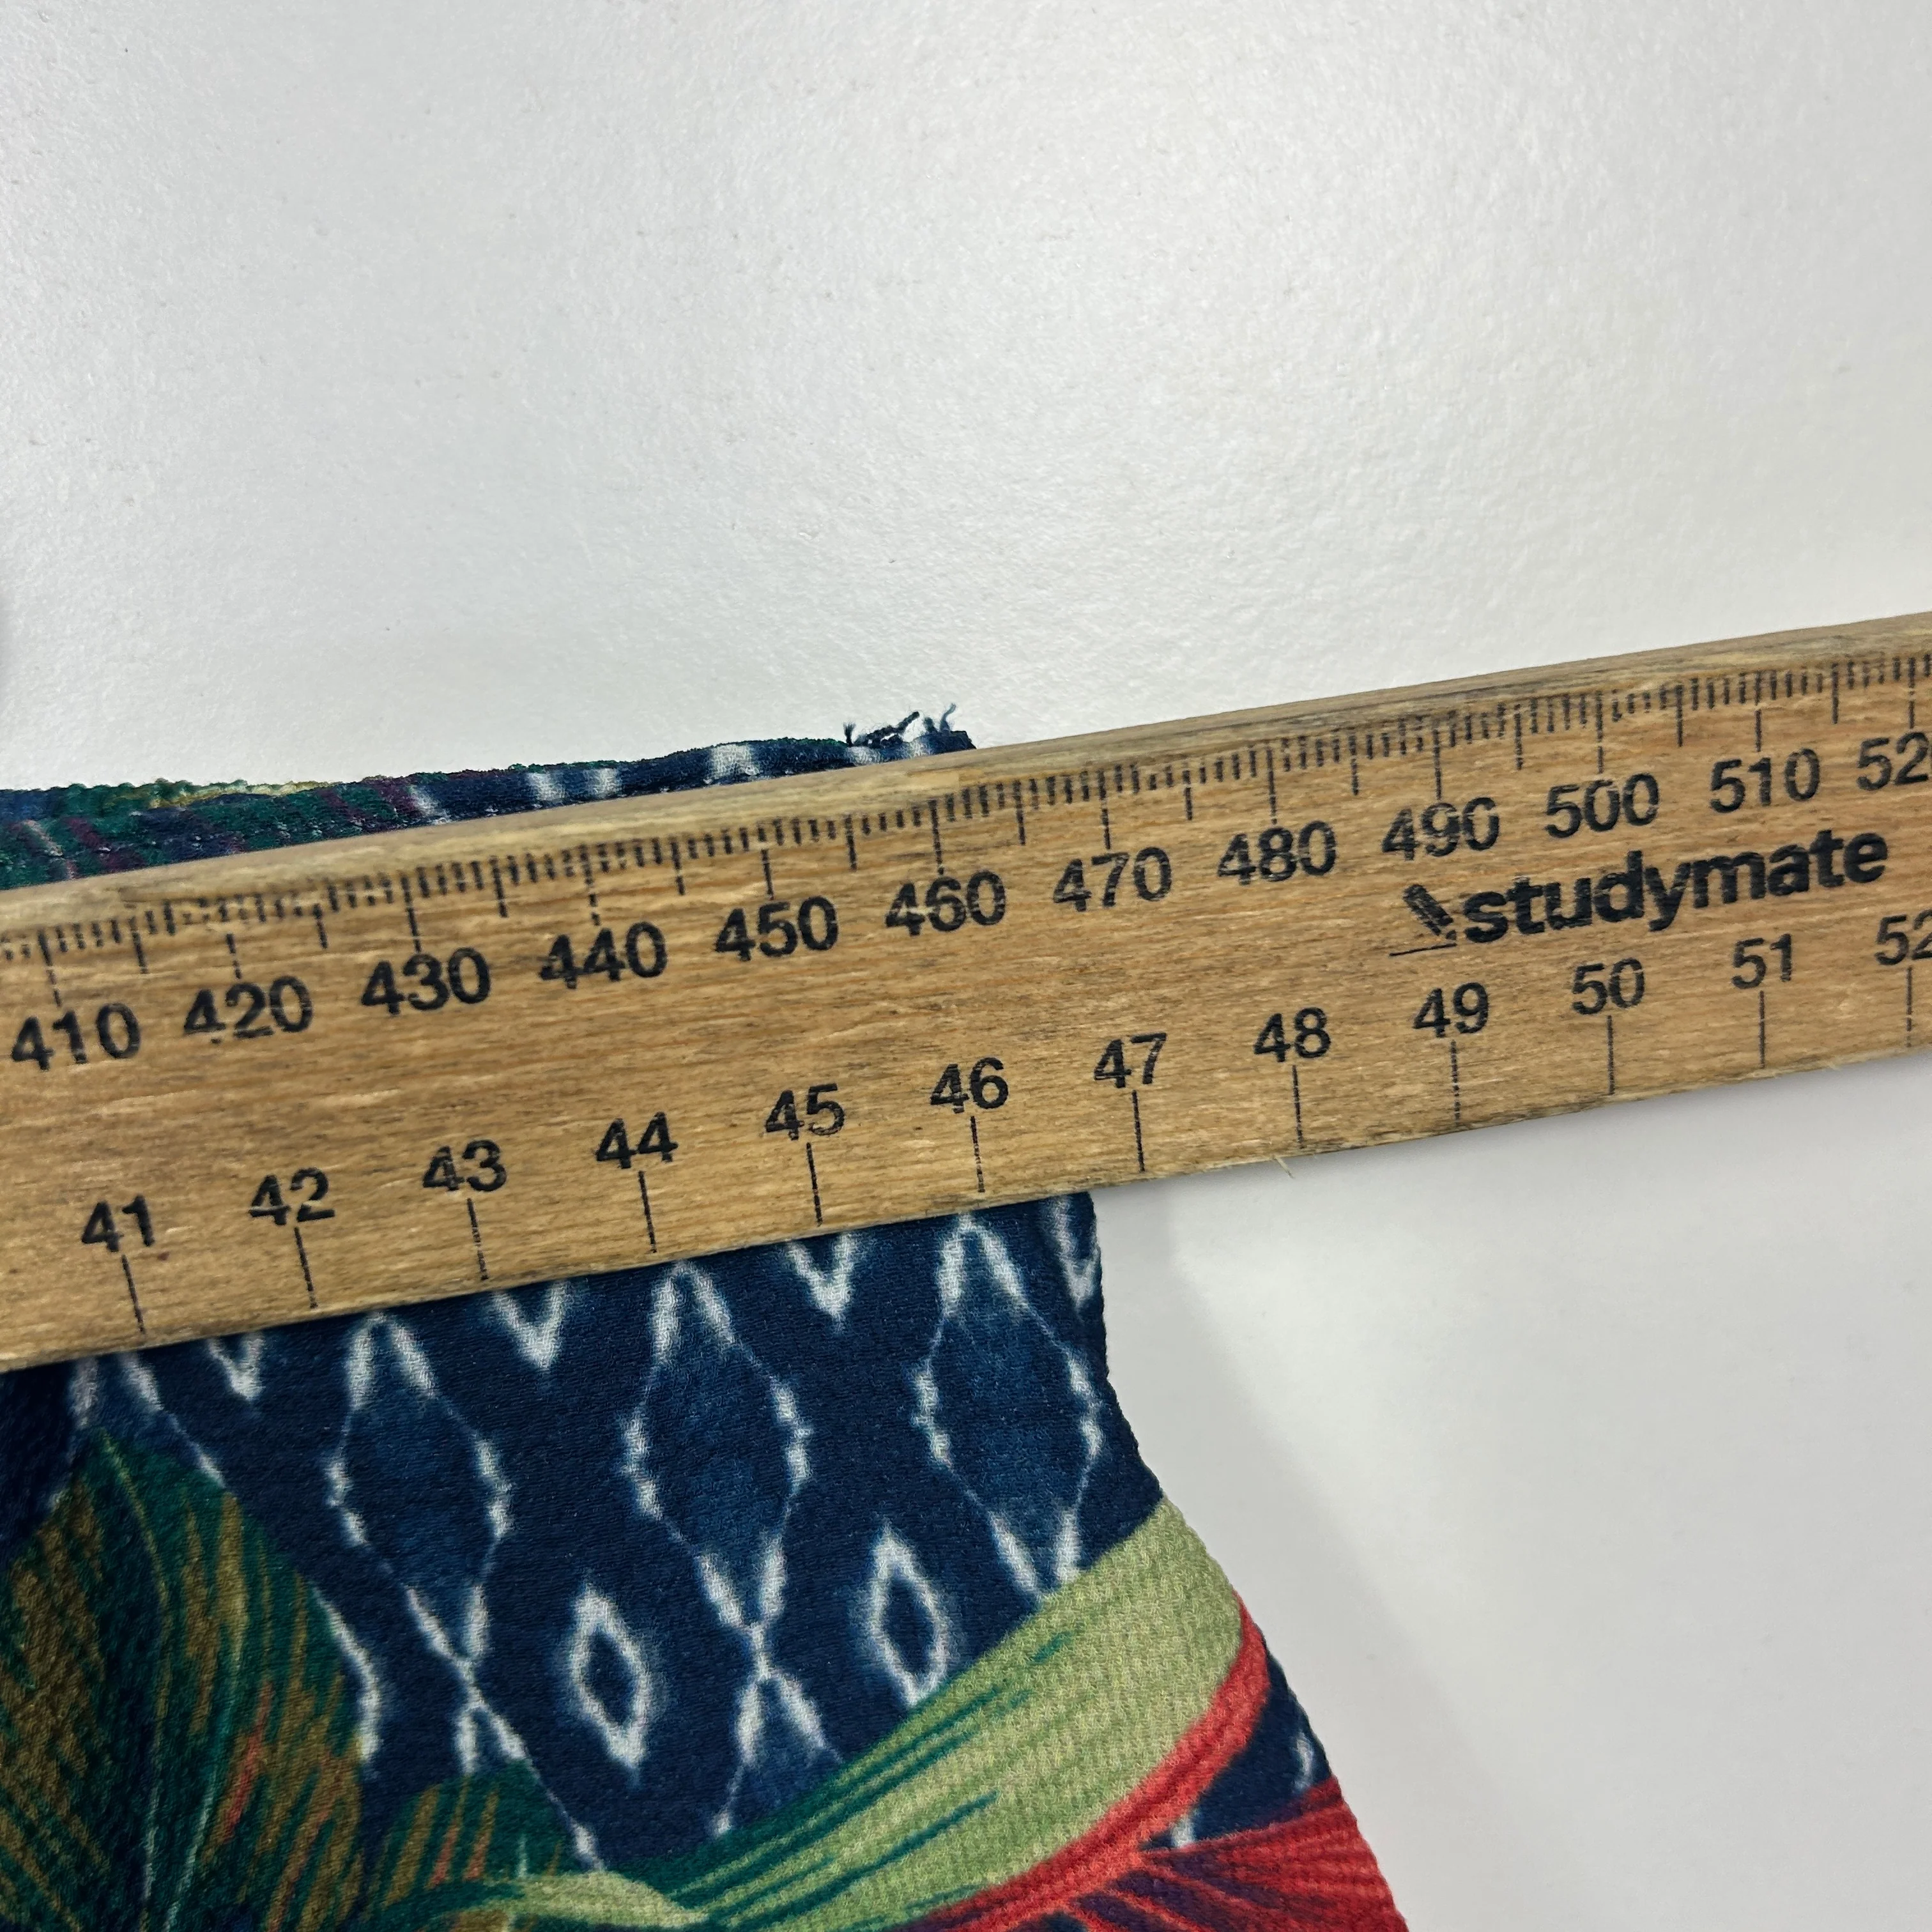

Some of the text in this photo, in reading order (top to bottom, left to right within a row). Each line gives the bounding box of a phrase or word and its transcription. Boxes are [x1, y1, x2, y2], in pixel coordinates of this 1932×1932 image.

[10, 731, 1932, 1070] 410 420 430 440 450 460 470 480 490 500 510 52
[1462, 829, 1888, 944] studymate
[81, 1194, 155, 1252] 41
[248, 1168, 335, 1225] 42
[422, 1139, 507, 1192] 43
[595, 1112, 678, 1169] 44
[765, 1083, 845, 1140] 45
[930, 1057, 1009, 1113] 46
[1093, 1032, 1167, 1088] 47
[1254, 1006, 1331, 1062] 48
[1413, 981, 1489, 1038] 49
[1572, 958, 1645, 1015] 50
[1732, 933, 1792, 989] 51
